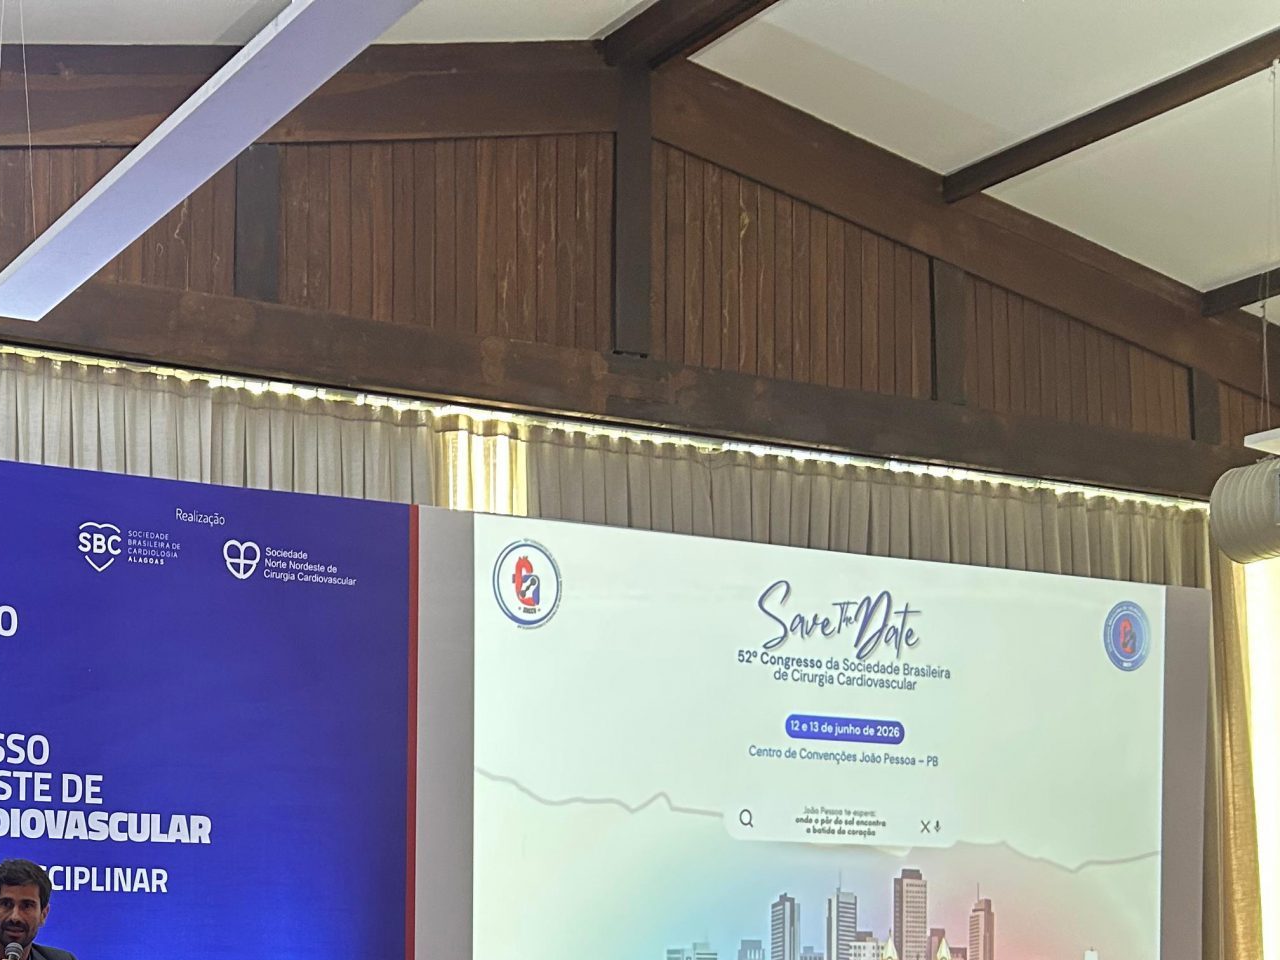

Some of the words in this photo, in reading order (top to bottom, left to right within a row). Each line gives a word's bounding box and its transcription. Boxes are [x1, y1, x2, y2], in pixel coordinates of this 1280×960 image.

[175, 508, 225, 527] Realização
[78, 531, 122, 556] SBC
[128, 530, 169, 540] SOCIEDADE
[128, 539, 170, 549] BRASILEIRA
[128, 547, 178, 558] CARDIOLOGIA
[128, 556, 165, 565] ALAGOAS
[265, 547, 308, 560] Sociedade
[265, 559, 287, 570] Norte
[289, 561, 325, 573] Nordeste
[327, 564, 337, 574] de
[263, 569, 295, 582] Cirurgia
[297, 572, 357, 586] Cardiovascular
[758, 580, 836, 650] Save
[832, 601, 858, 633] The
[854, 590, 922, 660] Date
[760, 652, 822, 670] Congresso
[826, 657, 839, 670] da
[843, 659, 900, 675] Sociedade
[903, 664, 951, 679] Brasileira
[774, 668, 788, 681] de
[791, 669, 834, 687] Cirurgia
[837, 673, 917, 690] Cardiovascular
[790, 720, 800, 731] 12
[802, 723, 808, 732] e
[810, 721, 819, 732] 13
[821, 722, 833, 733] de
[834, 723, 861, 737] junho
[863, 724, 875, 736] de
[877, 726, 900, 738] 2026
[749, 745, 782, 758] Centro
[784, 747, 797, 759] de
[799, 748, 856, 764] Convenções
[859, 751, 881, 764] João
[884, 754, 916, 765] Pessoa
[926, 756, 938, 767] PB
[62, 773, 103, 805] DE
